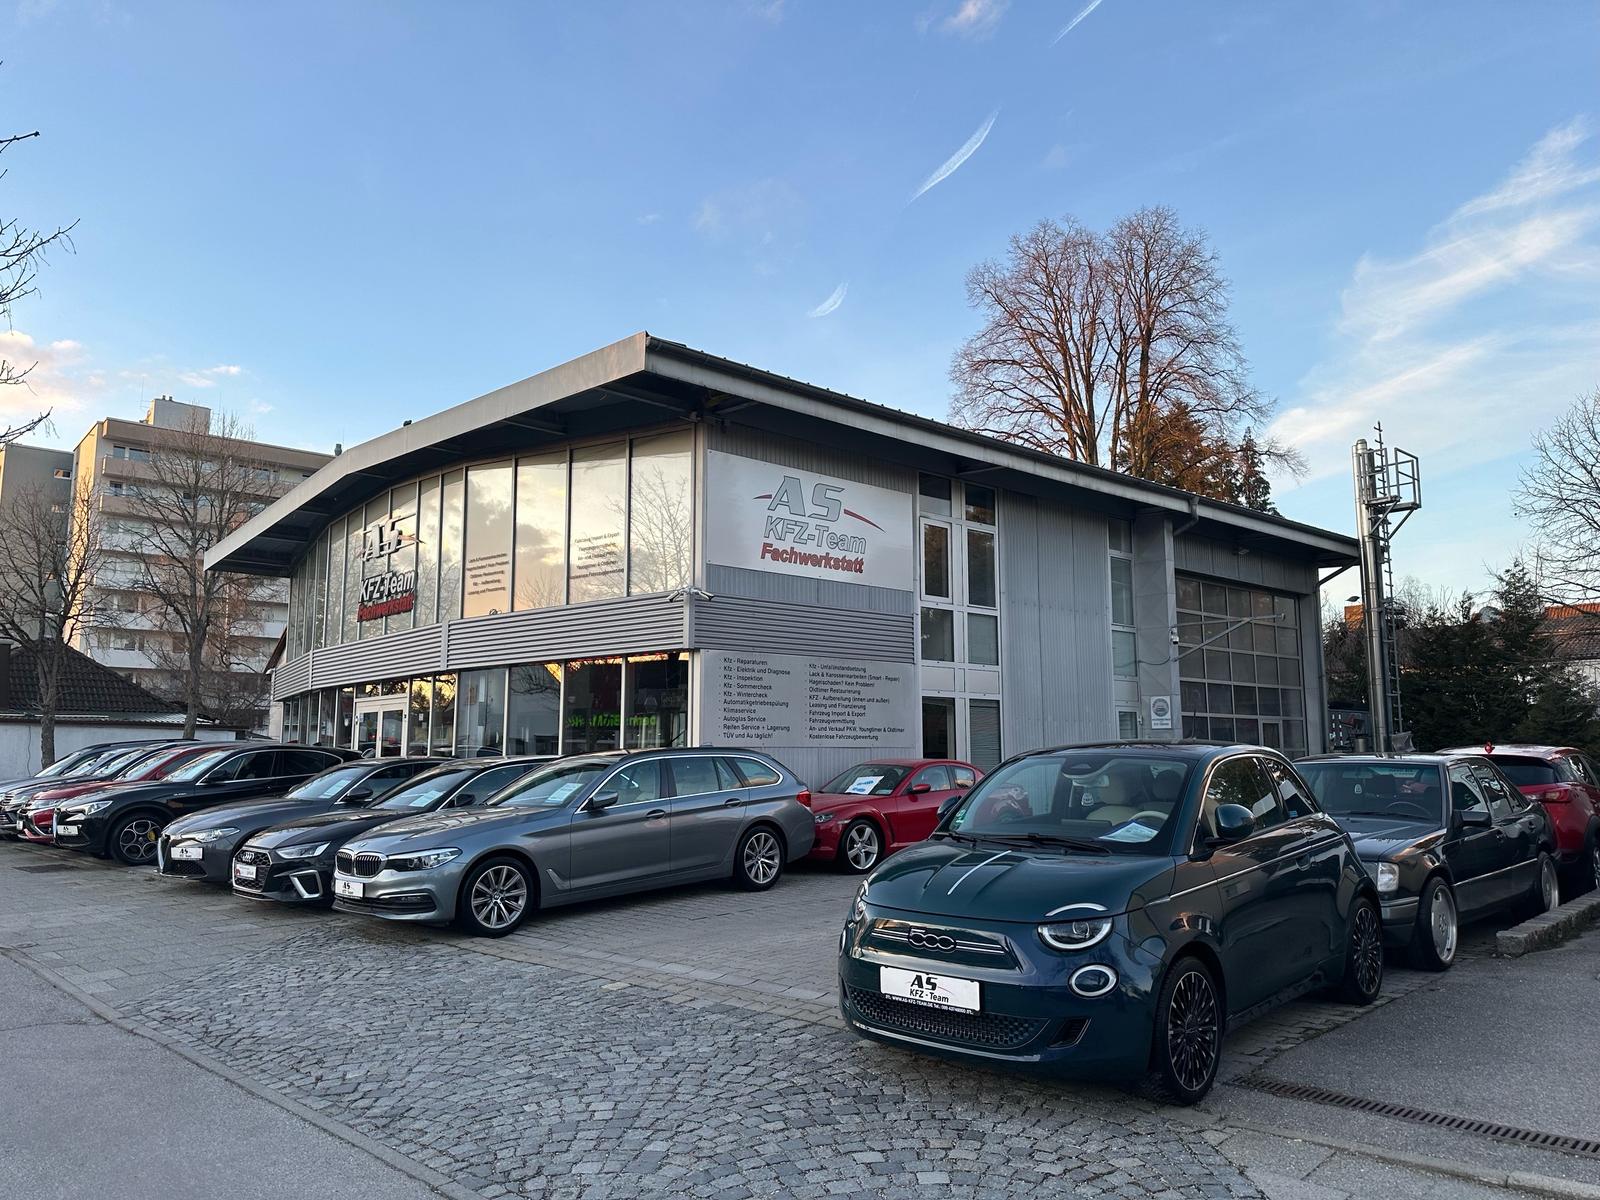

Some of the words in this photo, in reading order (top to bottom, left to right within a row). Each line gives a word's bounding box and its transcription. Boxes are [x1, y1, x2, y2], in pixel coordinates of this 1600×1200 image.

[768, 475, 845, 522] AS
[764, 516, 867, 554] KFZ-Team
[761, 542, 865, 574] Fachwerkstatt
[360, 570, 415, 602] KFZ-Team
[357, 592, 415, 622] Fachwerkstatt
[737, 682, 772, 690] Sommercheck
[909, 928, 956, 949] 500
[909, 988, 924, 998] KFZ
[930, 992, 949, 1003] Team
[910, 974, 938, 991] AS
